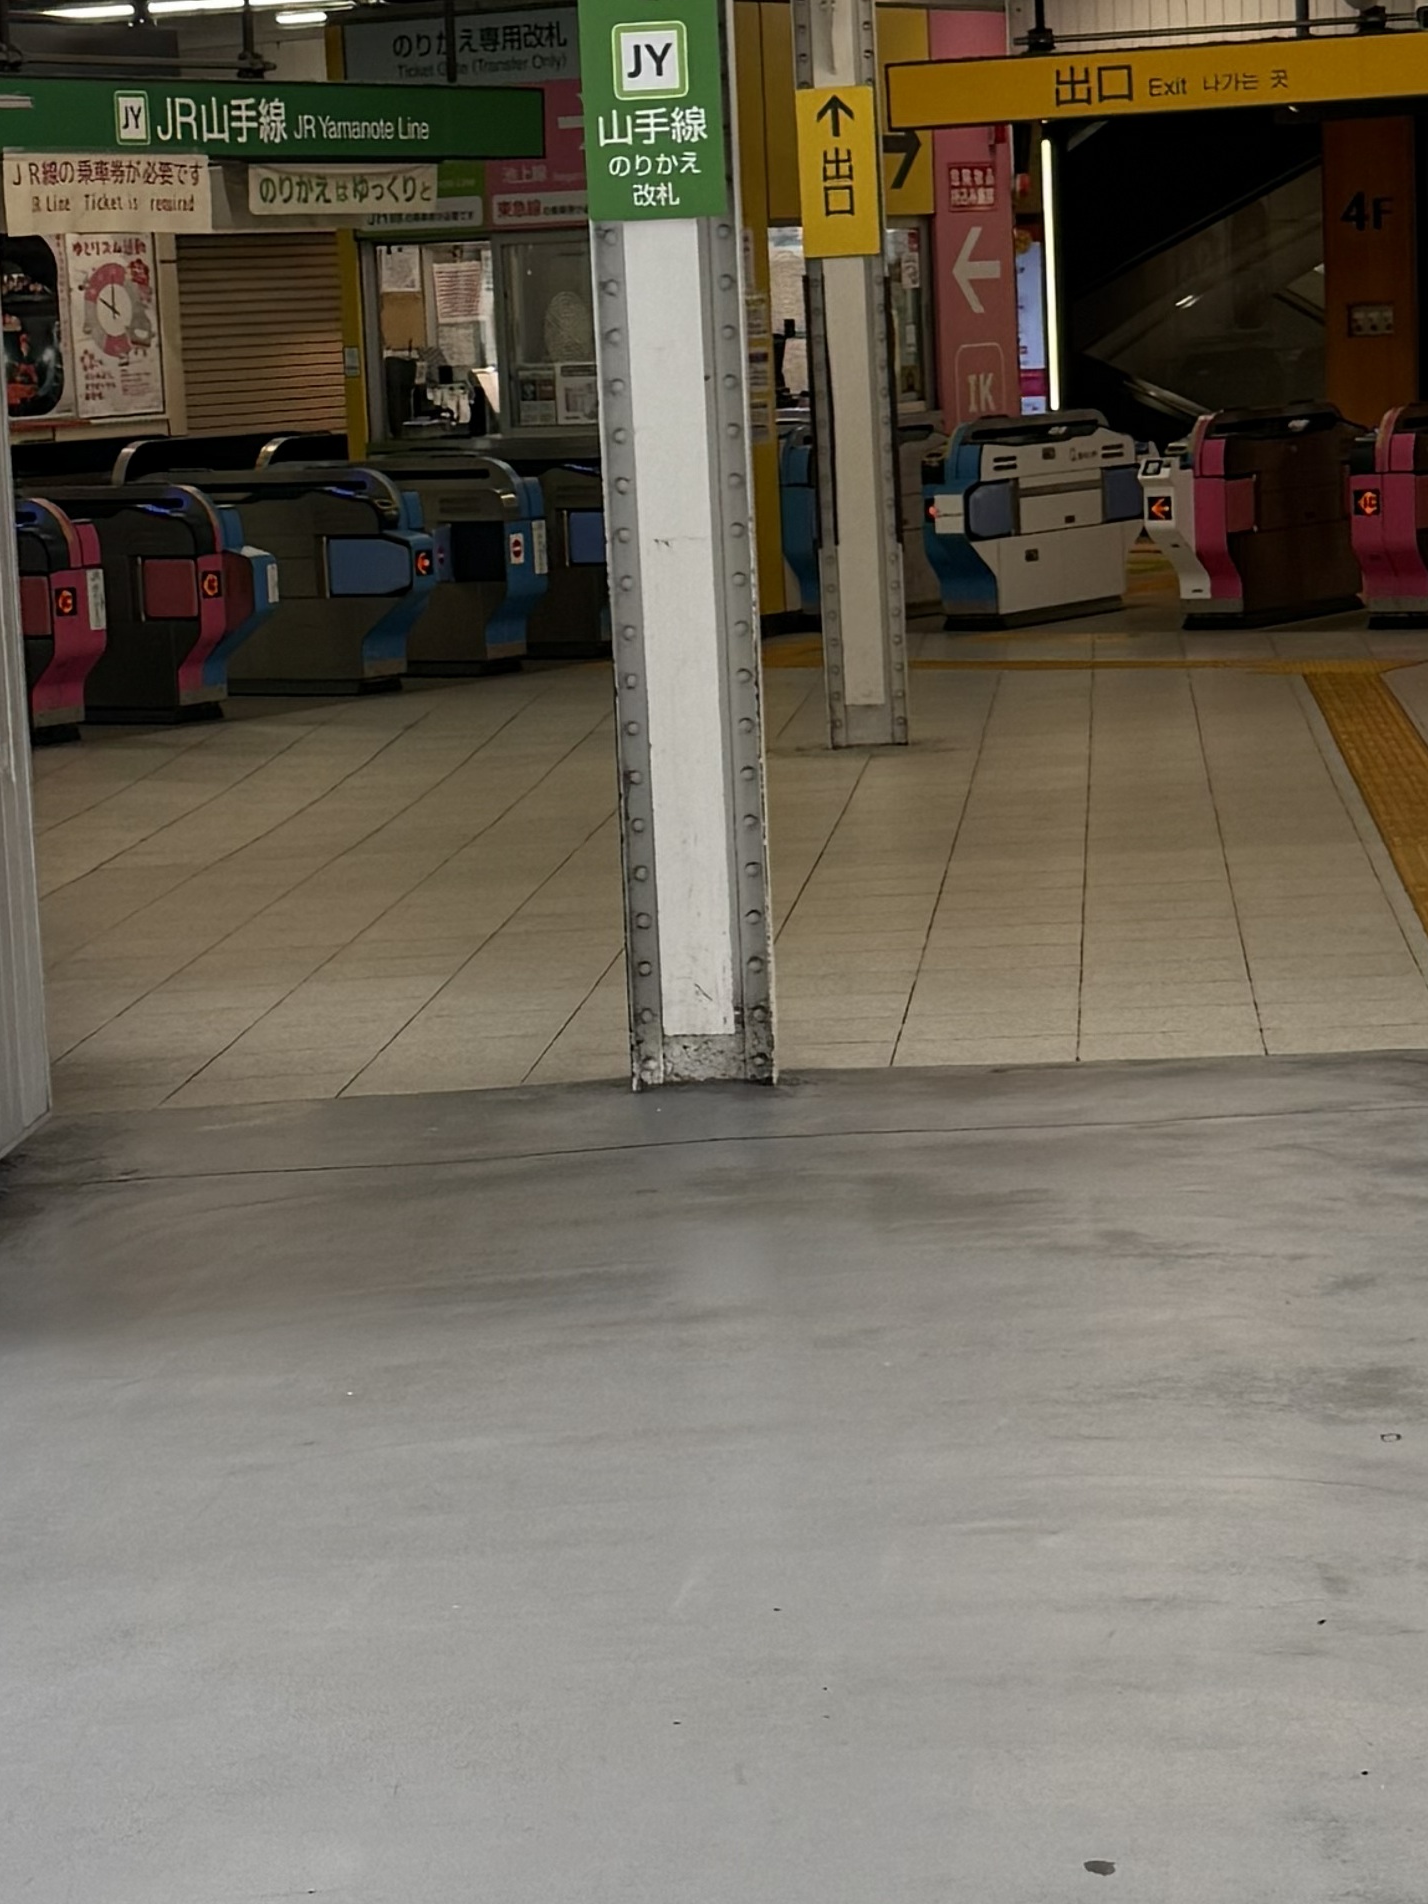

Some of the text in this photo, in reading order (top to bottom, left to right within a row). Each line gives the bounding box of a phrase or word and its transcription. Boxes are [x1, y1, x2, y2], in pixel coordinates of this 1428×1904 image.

[627, 41, 673, 80] JY
[1055, 64, 1289, 108] 出口 Exit 나가는 곳
[121, 105, 144, 131] JY
[157, 96, 430, 144] JR山手線 JR Yamanote Line
[598, 105, 709, 148] 山手線
[609, 150, 703, 177] のりかえ
[822, 146, 856, 217] 出口
[632, 182, 681, 208] 改札
[1340, 190, 1395, 232] 4F
[967, 371, 997, 414] IK
